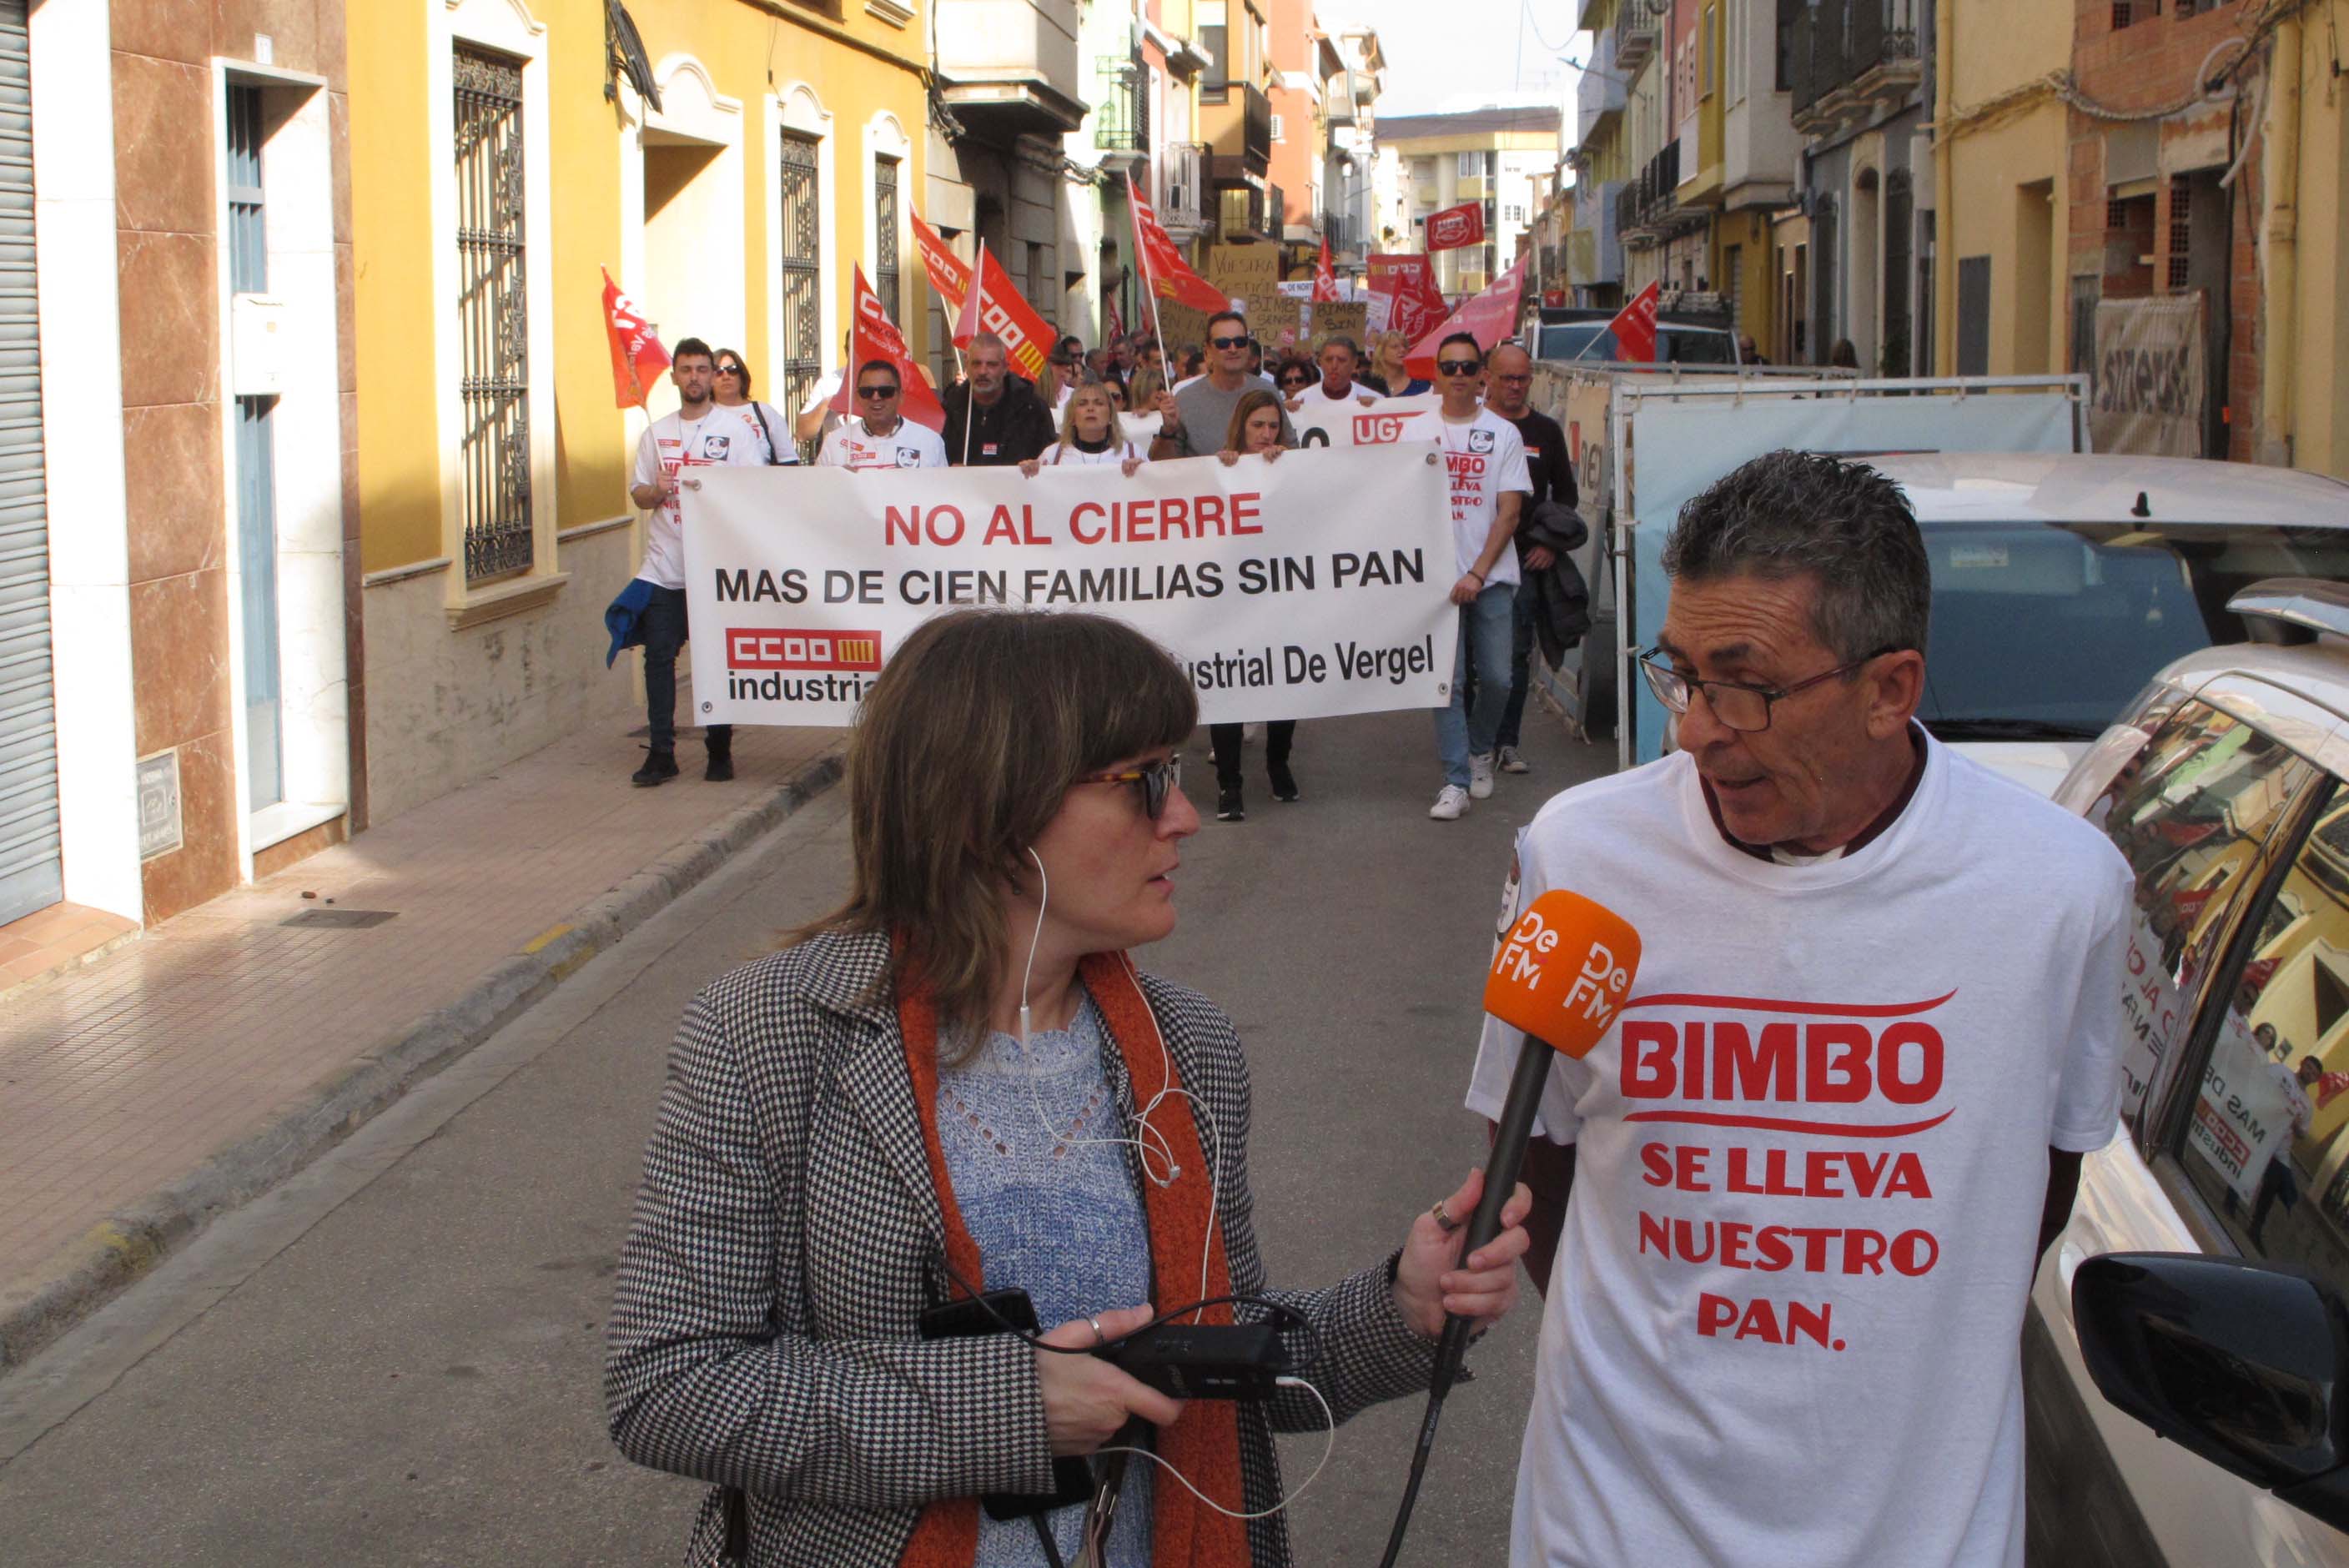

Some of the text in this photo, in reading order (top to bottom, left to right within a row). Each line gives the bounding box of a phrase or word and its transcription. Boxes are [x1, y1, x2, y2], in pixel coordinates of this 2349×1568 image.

[980, 287, 1025, 349] COO
[1318, 302, 1366, 317] BIMBO
[1325, 319, 1356, 330] SIN
[885, 492, 1264, 546] NO AL CIERRE
[715, 547, 1425, 606] MAS DE CIEN FAMILIAS SIN PAN
[733, 636, 832, 662] CCOO
[1283, 645, 1327, 684] De
[1335, 634, 1435, 685] Vergel
[1496, 942, 1542, 991] FM
[1562, 975, 1613, 1030] FM
[1619, 1020, 1945, 1104] BIMBO
[1640, 1142, 1933, 1199] SE LLEVA
[1638, 1210, 1939, 1277] NUESTRO
[1697, 1292, 1846, 1352] PAN.
